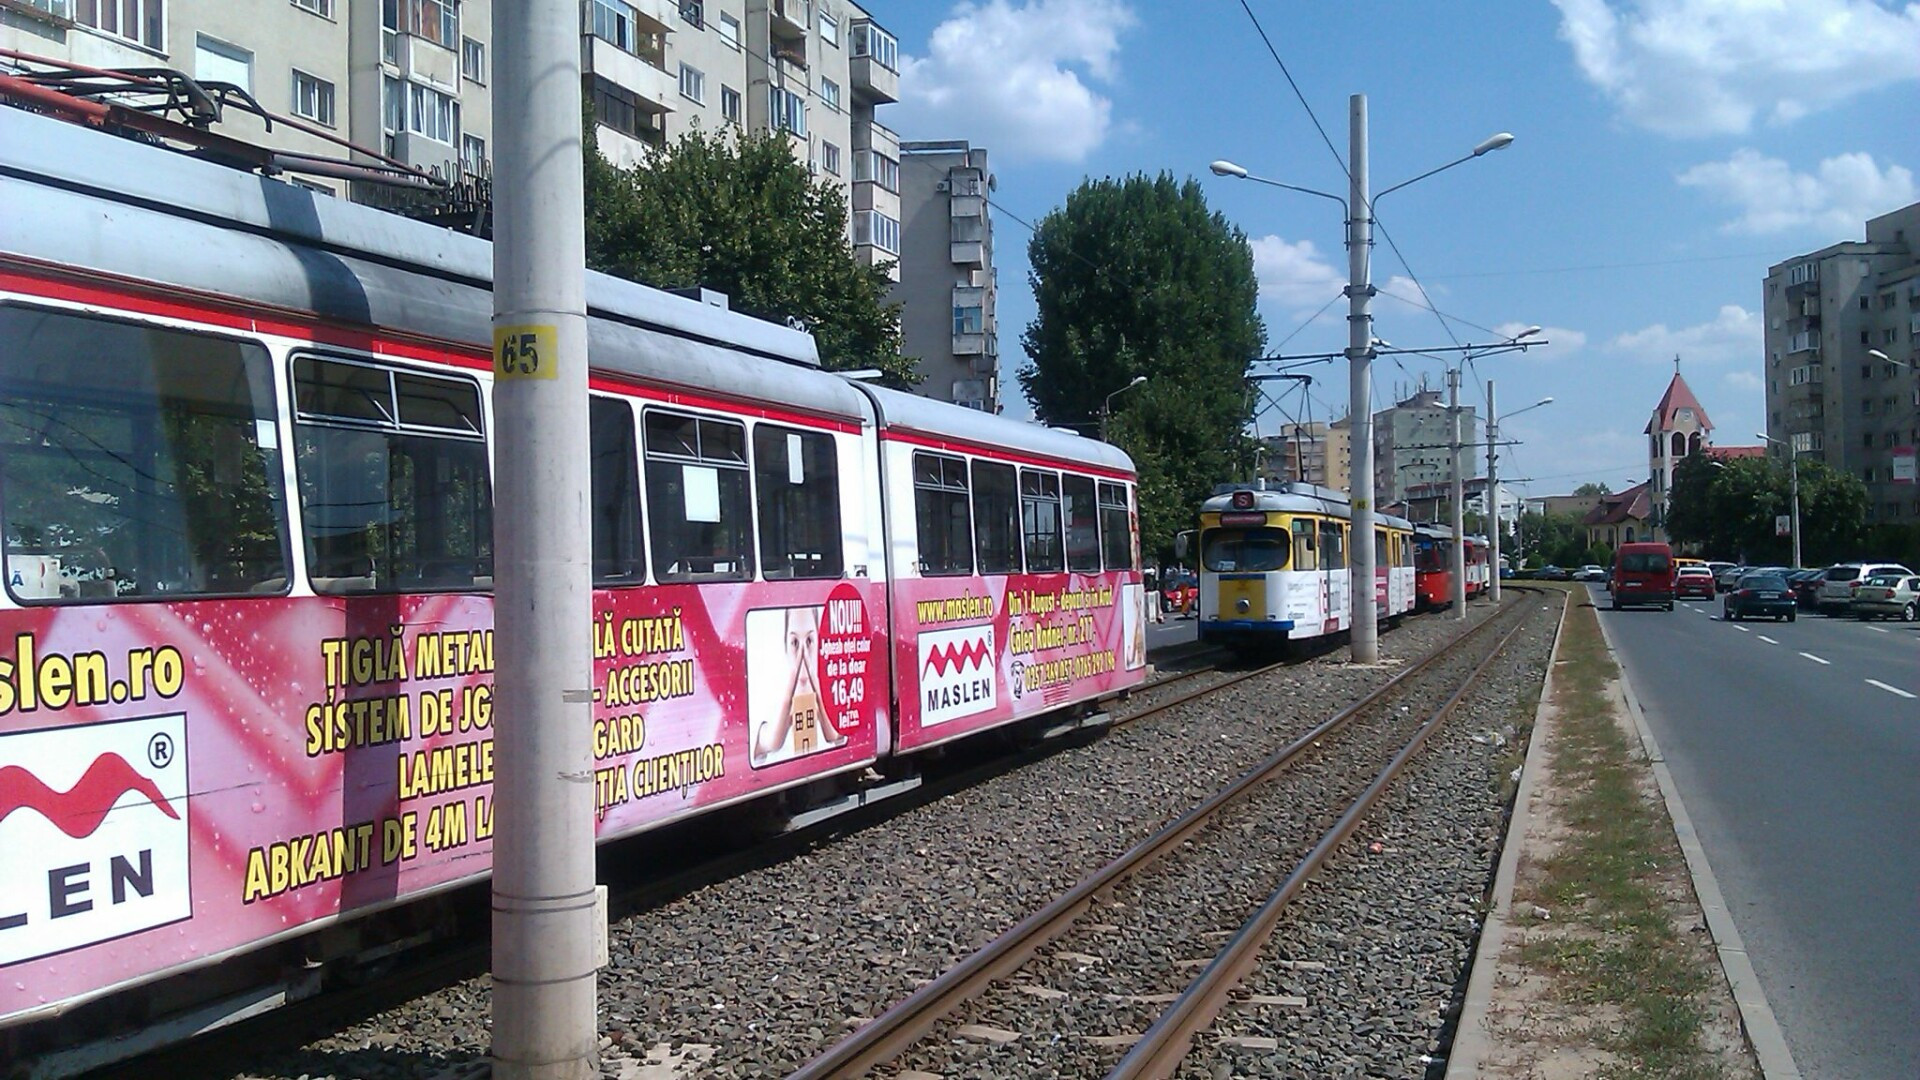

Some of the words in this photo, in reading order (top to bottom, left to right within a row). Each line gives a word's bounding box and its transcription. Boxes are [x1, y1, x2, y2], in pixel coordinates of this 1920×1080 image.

[502, 333, 539, 374] 65
[829, 599, 862, 635] NOU!!!
[917, 588, 994, 625] www.maslen.ro
[1030, 589, 1055, 618] August
[321, 625, 408, 704] ȚIGLĂ
[621, 607, 685, 657] CUTATĂ
[1010, 621, 1034, 656] Calea
[827, 659, 838, 677] de
[839, 658, 847, 675] la
[848, 657, 866, 674] doar
[305, 693, 412, 757] SISTEM
[420, 688, 453, 739] DE
[459, 683, 495, 733] JG
[605, 659, 694, 708] ACCESORII
[831, 677, 864, 709] 16,49
[928, 678, 990, 711] MASLEN
[398, 741, 495, 800] LAMELE
[593, 713, 645, 761] GARD
[242, 818, 375, 905] ABKANT
[381, 811, 417, 863] DE
[424, 801, 468, 853] 4M
[594, 764, 629, 823] ȚIA
[633, 743, 725, 800] CLIENȚILOR
